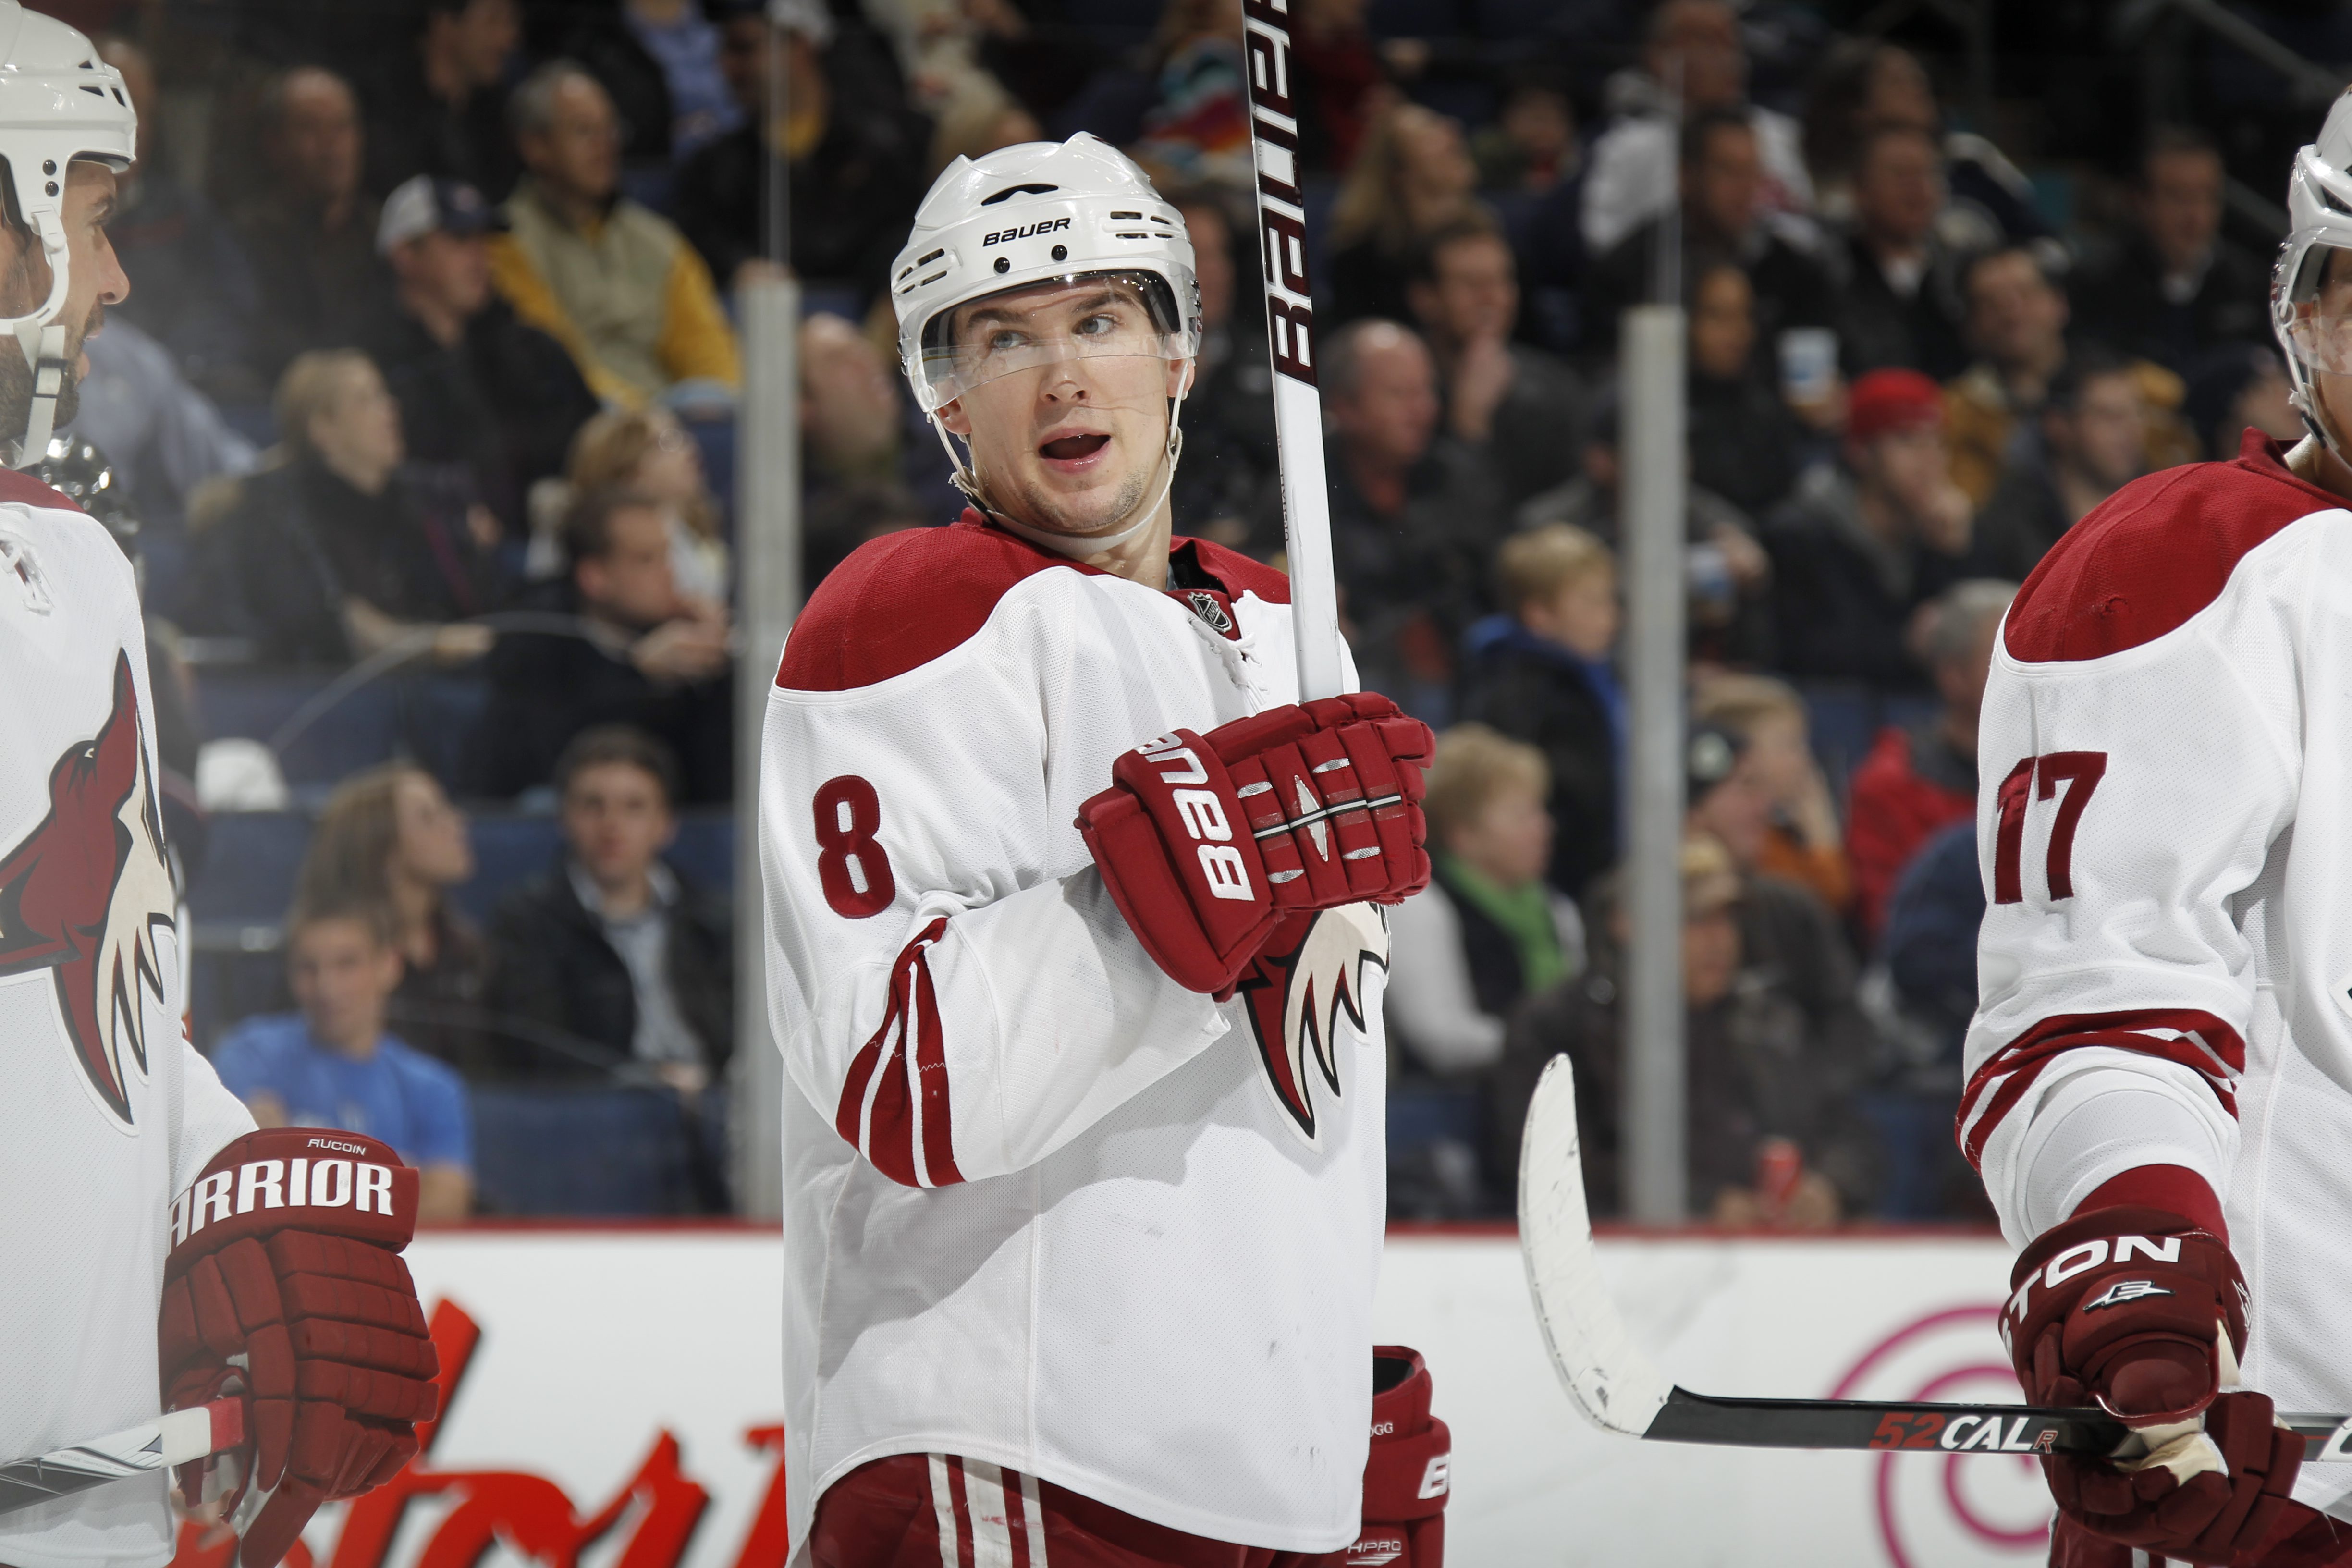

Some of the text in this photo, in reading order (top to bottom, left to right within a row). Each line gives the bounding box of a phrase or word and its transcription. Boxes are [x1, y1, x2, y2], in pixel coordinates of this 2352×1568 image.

[983, 218, 1071, 247] BAUER
[813, 775, 896, 919] 8
[1995, 751, 2108, 904] 17
[307, 1139, 366, 1156] AUCOIN
